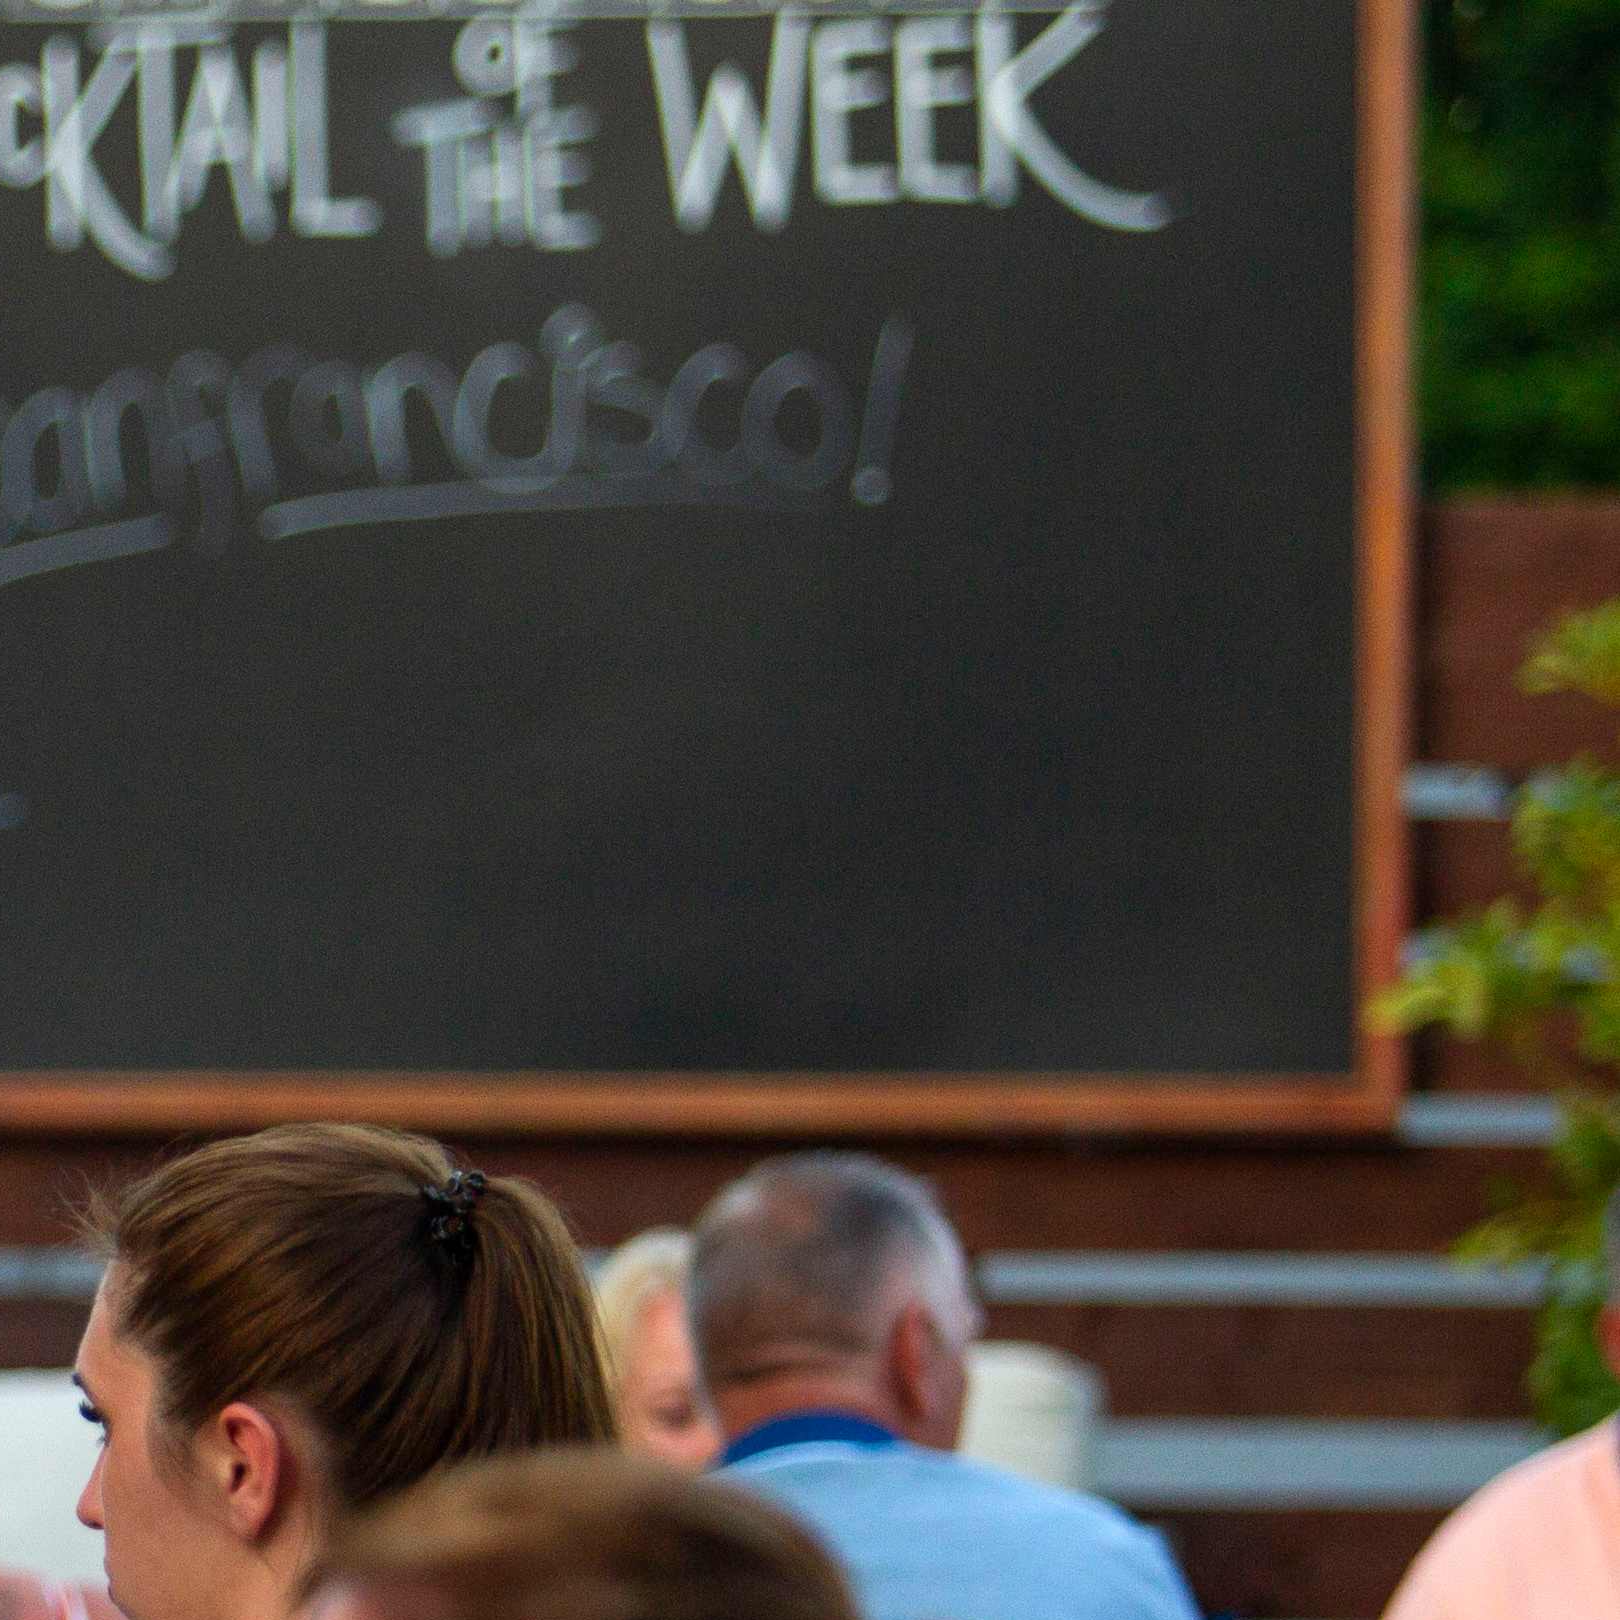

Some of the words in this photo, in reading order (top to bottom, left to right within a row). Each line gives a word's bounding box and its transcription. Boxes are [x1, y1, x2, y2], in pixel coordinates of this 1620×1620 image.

[453, 6, 580, 116] OF
[645, 4, 1176, 231] WEEK
[388, 99, 602, 257] THE
